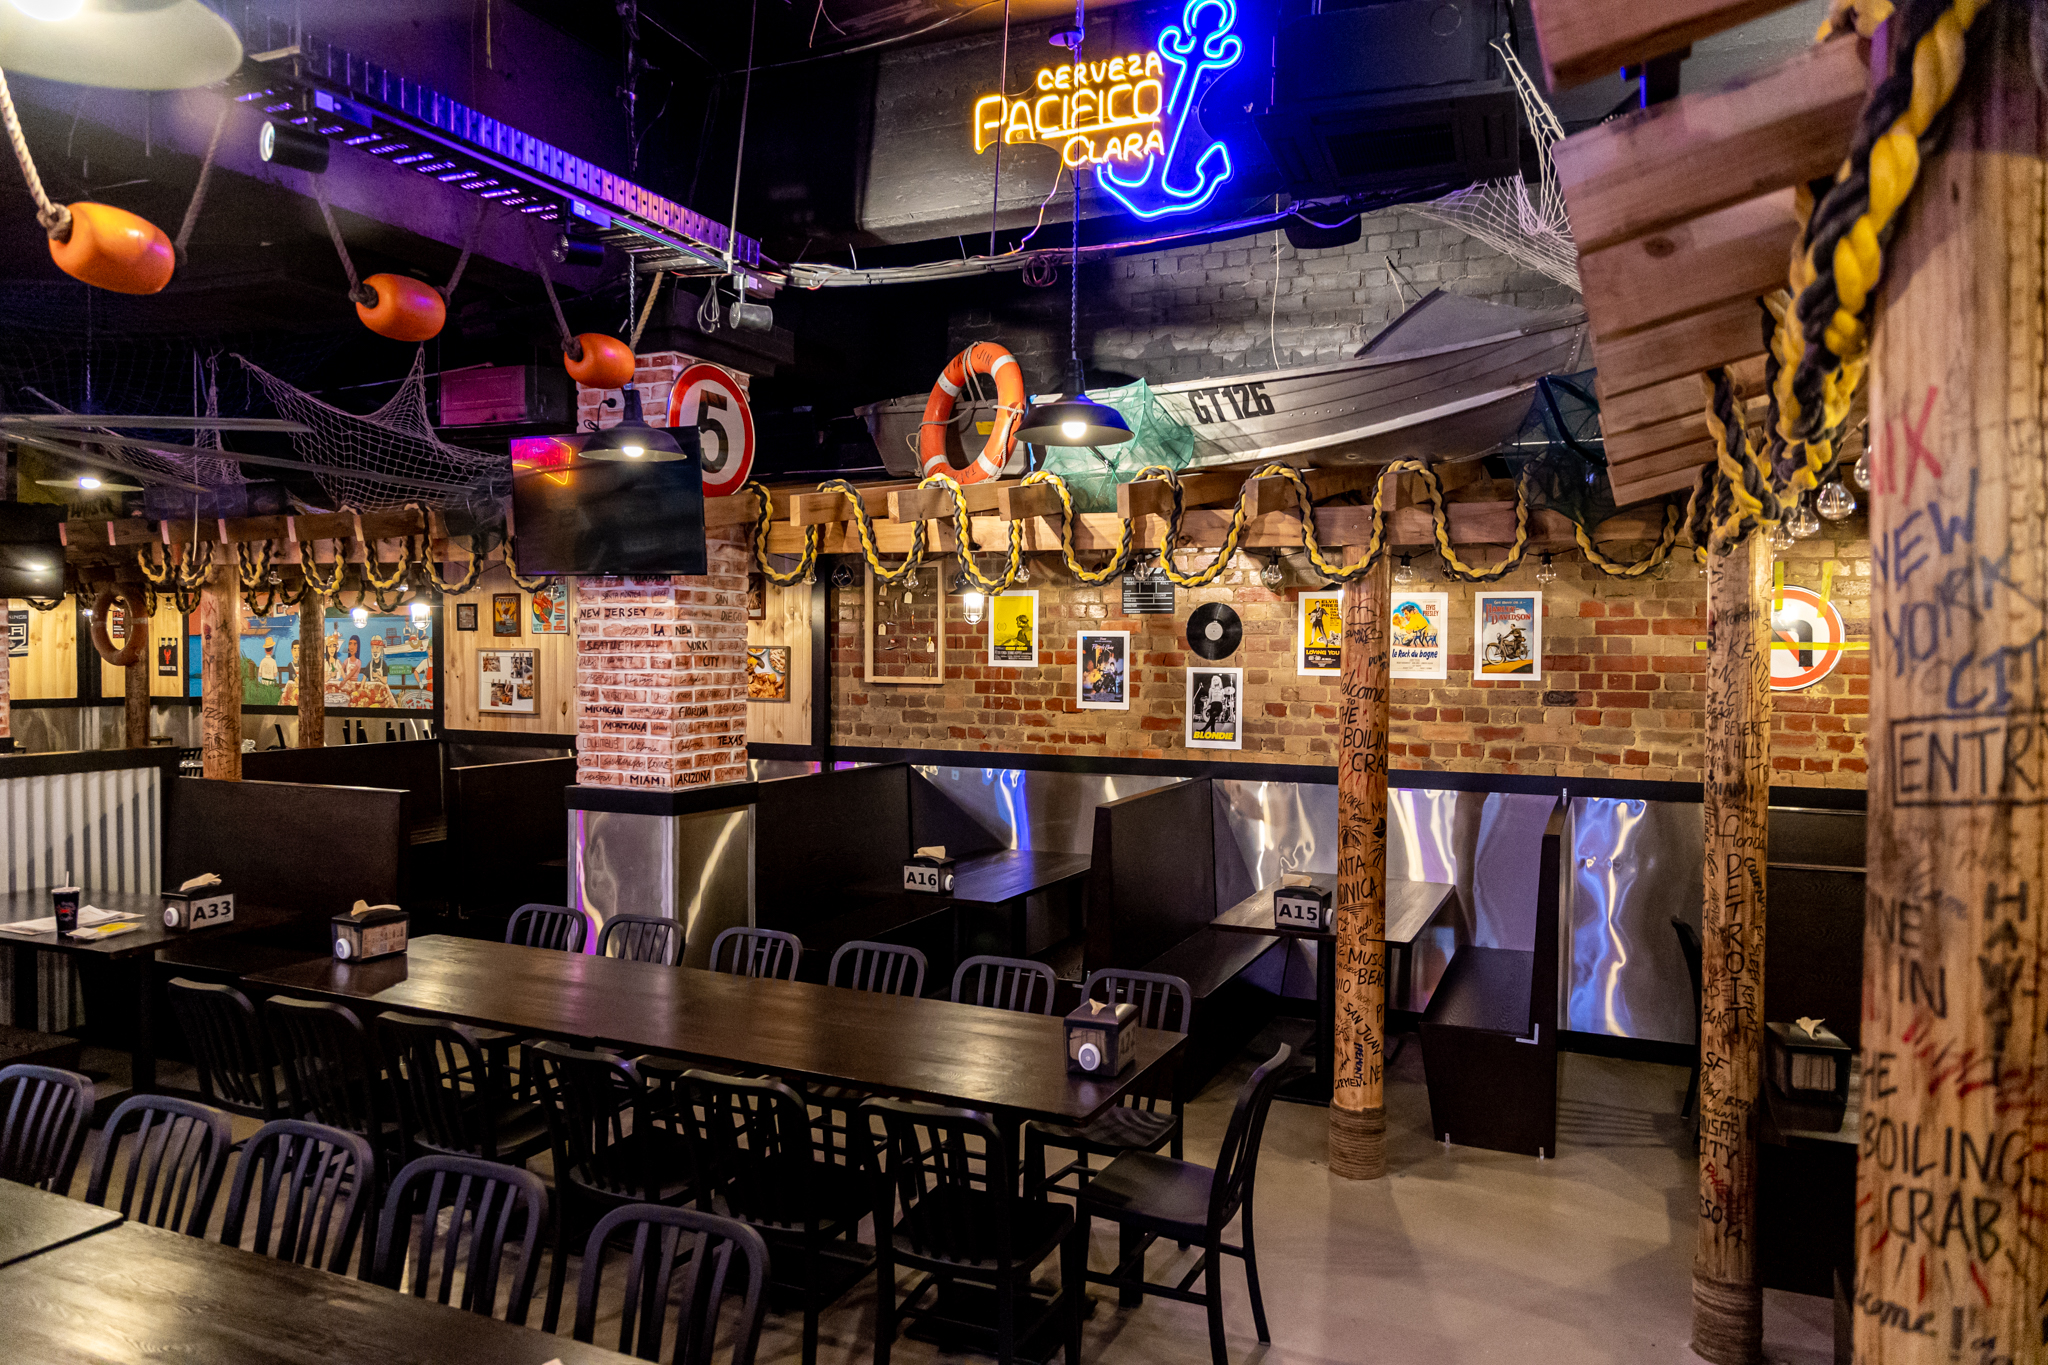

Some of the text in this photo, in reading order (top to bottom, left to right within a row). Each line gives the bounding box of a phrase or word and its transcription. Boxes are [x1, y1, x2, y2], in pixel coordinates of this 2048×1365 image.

[1037, 50, 1165, 91] CERVEZA
[974, 78, 1164, 155] PACIFICO
[1063, 128, 1165, 168] CLARA
[1187, 381, 1276, 425] GT126
[580, 607, 601, 618] NEW
[604, 607, 648, 618] JERSEY
[1490, 612, 1532, 625] DAVIDSON
[653, 623, 665, 637] LA
[675, 625, 692, 635] NEW
[702, 655, 720, 667] CITY
[584, 705, 624, 716] MICHIGAN
[603, 721, 647, 733] MONTANA
[717, 735, 744, 747] TEXAS
[1193, 730, 1235, 741] BLONDIE
[676, 769, 711, 786] ARIZONA
[906, 870, 937, 886] A16
[192, 900, 232, 922] A33
[1278, 903, 1318, 921] A15
[1725, 853, 1748, 1034] DETROIT
[1861, 1110, 2030, 1185] BOILING
[1886, 1183, 2002, 1263] CRAB
